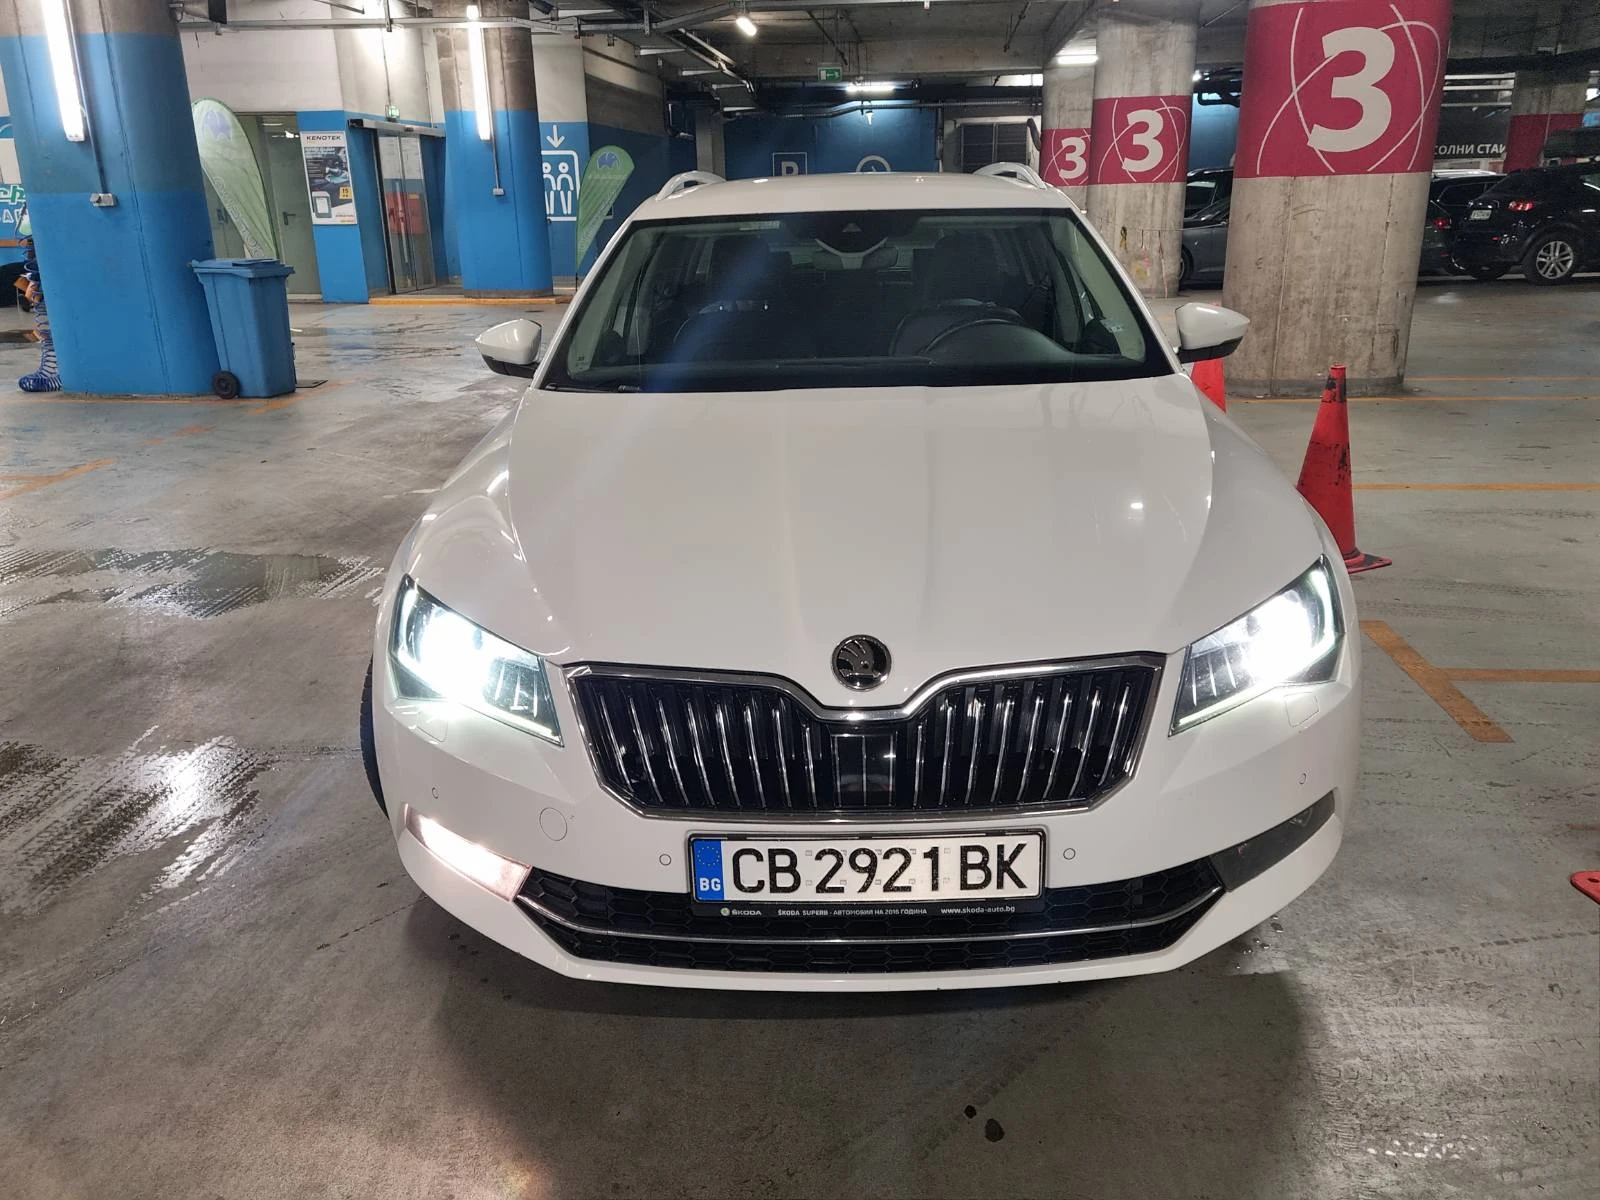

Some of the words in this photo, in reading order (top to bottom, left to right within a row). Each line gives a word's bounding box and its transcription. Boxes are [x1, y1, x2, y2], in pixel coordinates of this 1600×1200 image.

[1307, 26, 1397, 153] 3
[1059, 136, 1087, 179] 3
[1121, 109, 1164, 173] 3
[699, 877, 721, 891] BG
[814, 846, 940, 894] 2921
[940, 906, 1016, 915] www.skoda-auto.bg
